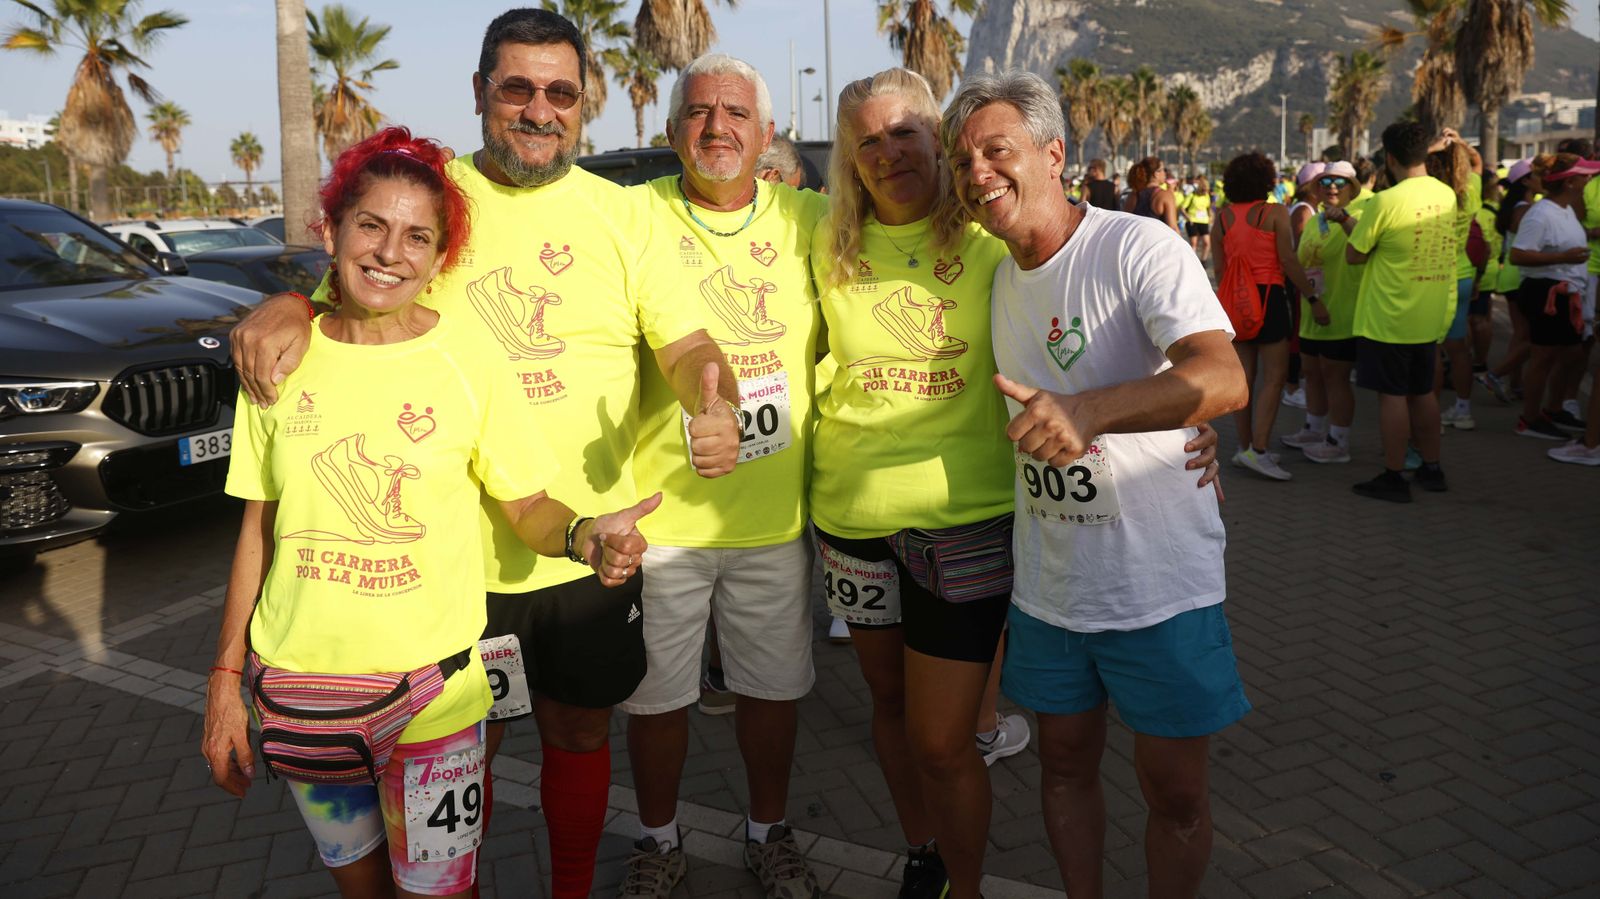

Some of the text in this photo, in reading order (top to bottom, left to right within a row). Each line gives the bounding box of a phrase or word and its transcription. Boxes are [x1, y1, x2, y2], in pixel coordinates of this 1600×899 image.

[516, 369, 557, 384] ERA
[738, 360, 784, 378] MUJER
[862, 367, 960, 382] VII CARRERA
[523, 380, 566, 398] UJER
[863, 380, 889, 392] POR
[893, 380, 912, 392] LA
[917, 378, 966, 396] MUJER
[195, 433, 232, 458] 383
[1023, 463, 1098, 502] 903
[297, 548, 413, 573] VII CARRERA
[296, 565, 421, 590] POR LA MUJER
[825, 571, 886, 611] 492
[481, 648, 512, 662] UJER
[432, 767, 463, 782] POR
[466, 762, 478, 775] LA
[427, 782, 482, 834] 49
